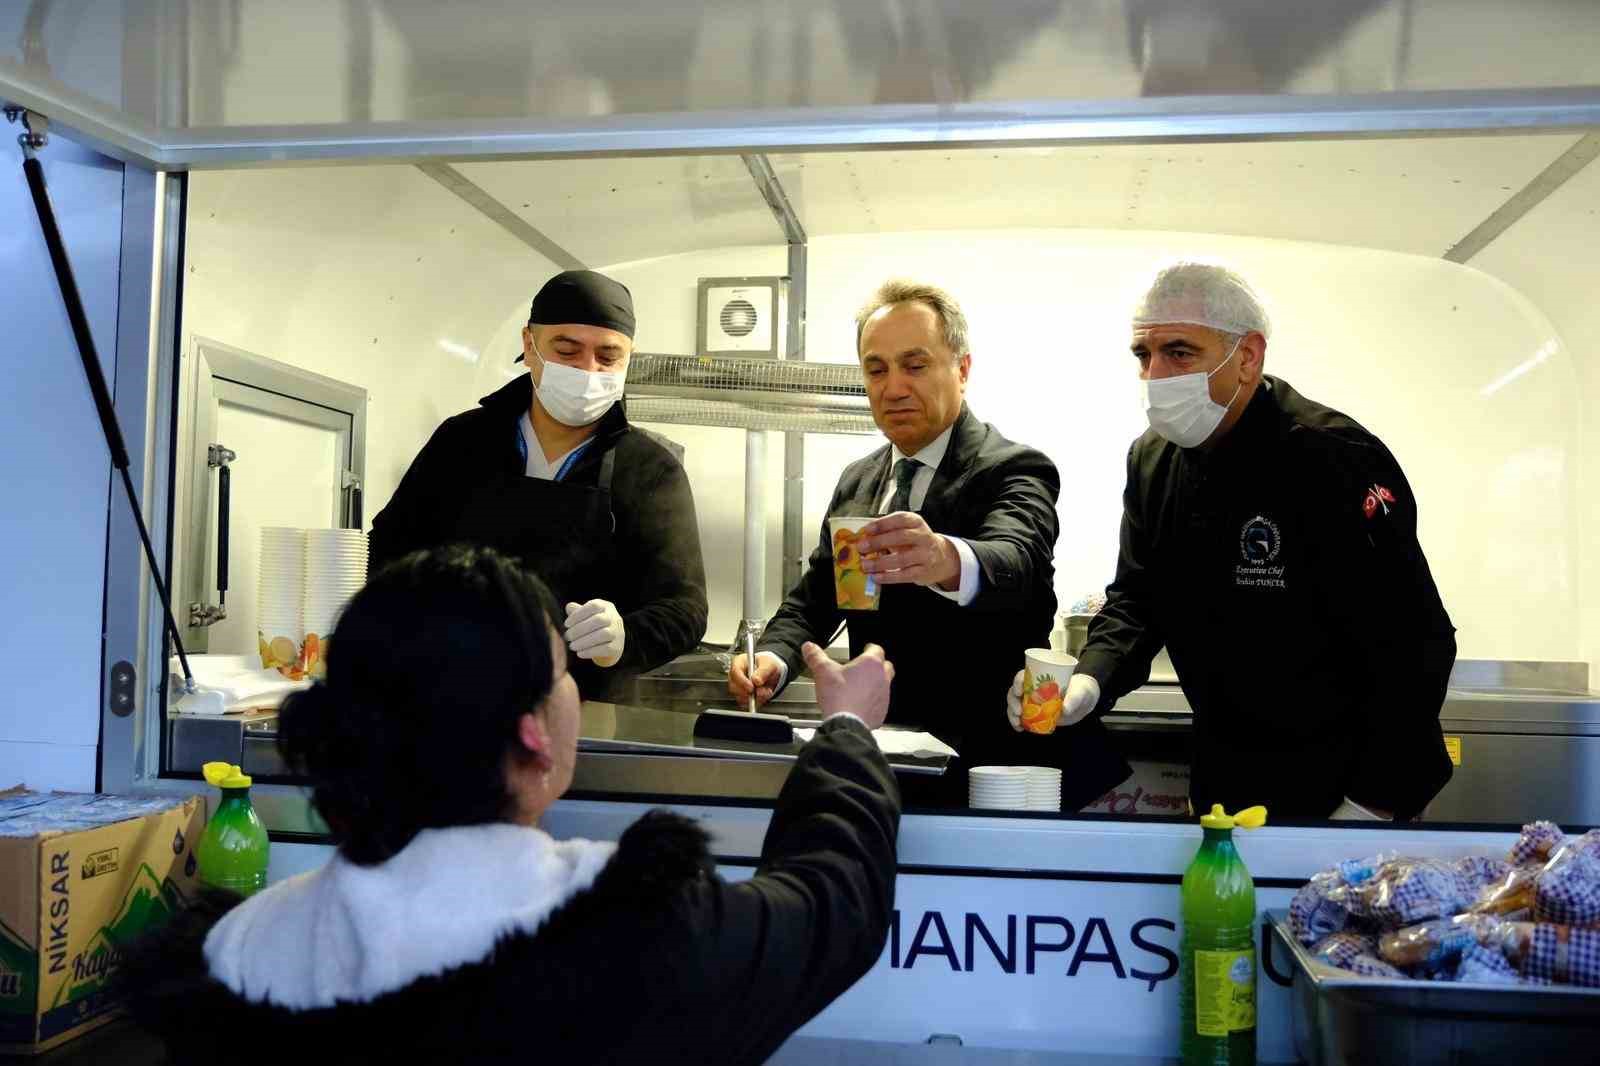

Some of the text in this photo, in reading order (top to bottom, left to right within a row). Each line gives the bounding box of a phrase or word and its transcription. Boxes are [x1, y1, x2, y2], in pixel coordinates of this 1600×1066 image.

[1267, 565, 1286, 578] Chef
[46, 850, 70, 974] NİKSAR
[890, 909, 1180, 992] ANPAŞ
